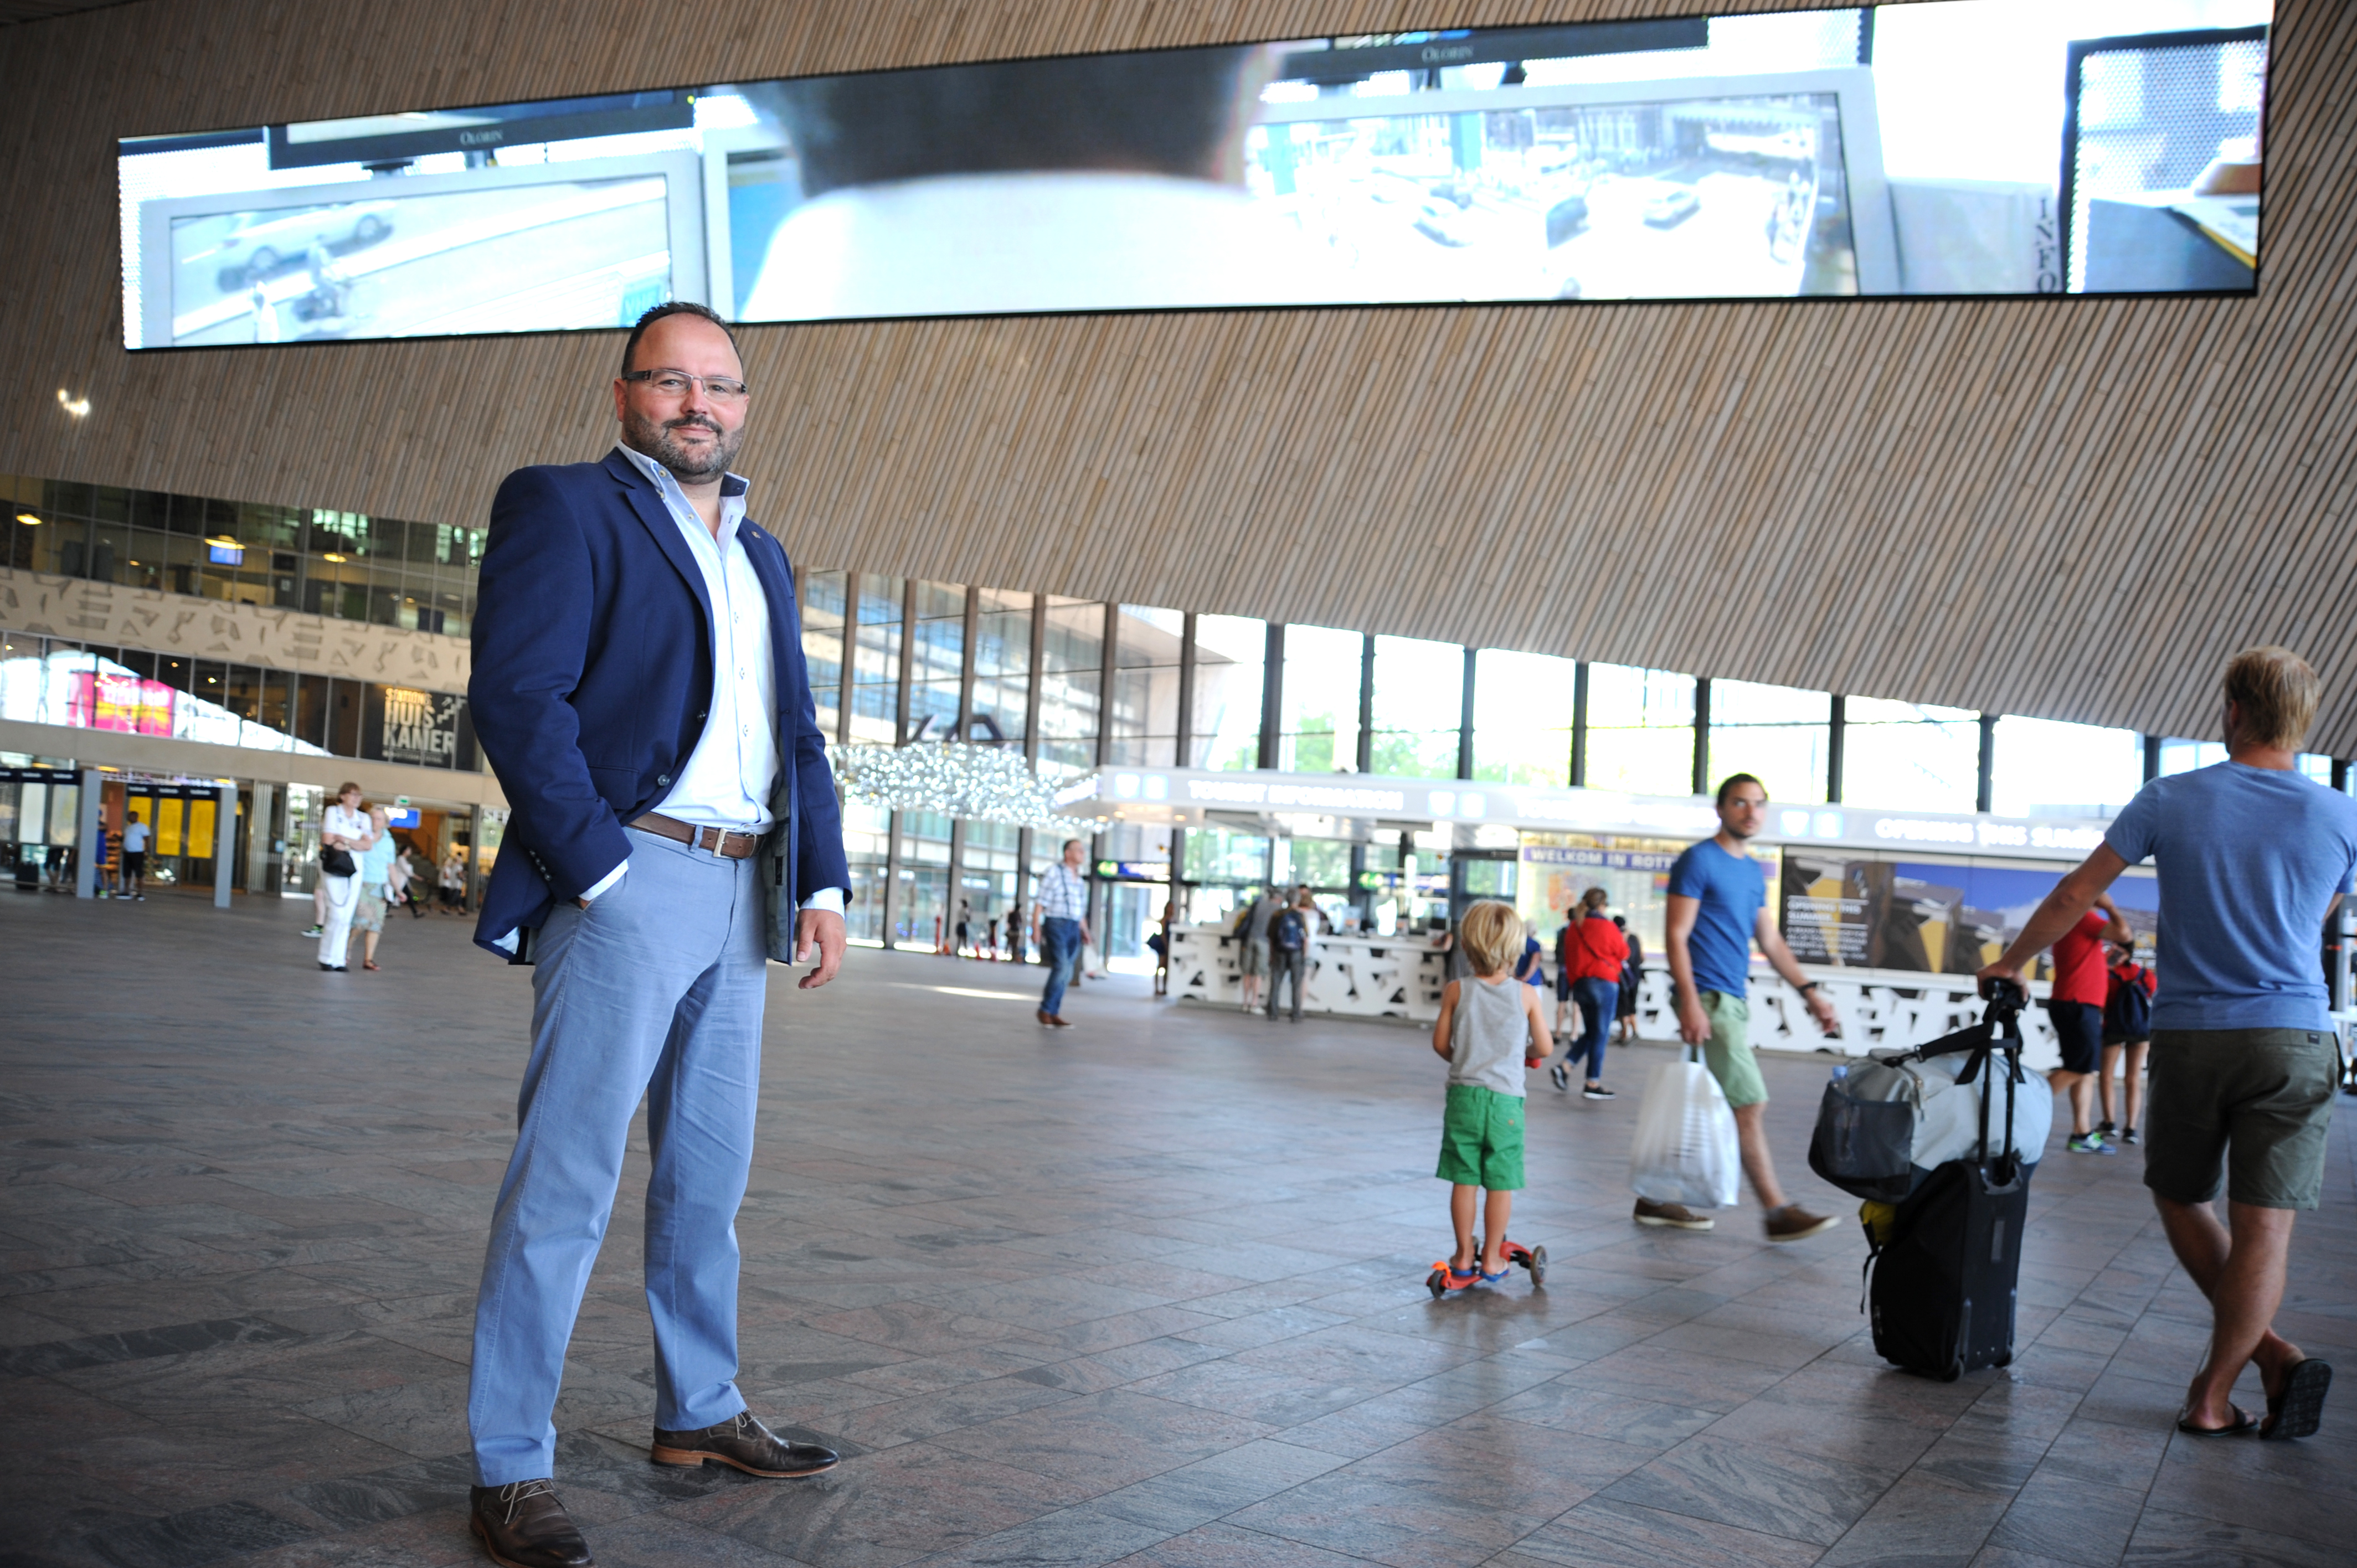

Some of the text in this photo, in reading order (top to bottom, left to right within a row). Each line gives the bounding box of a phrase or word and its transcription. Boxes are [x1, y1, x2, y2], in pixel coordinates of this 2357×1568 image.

[2035, 197, 2057, 293] INFO
[384, 700, 435, 729] HUIS
[1875, 818, 1974, 843] OPENING
[1976, 822, 2027, 846] THIS
[1531, 848, 1675, 869] WELKOM IN ROTT
